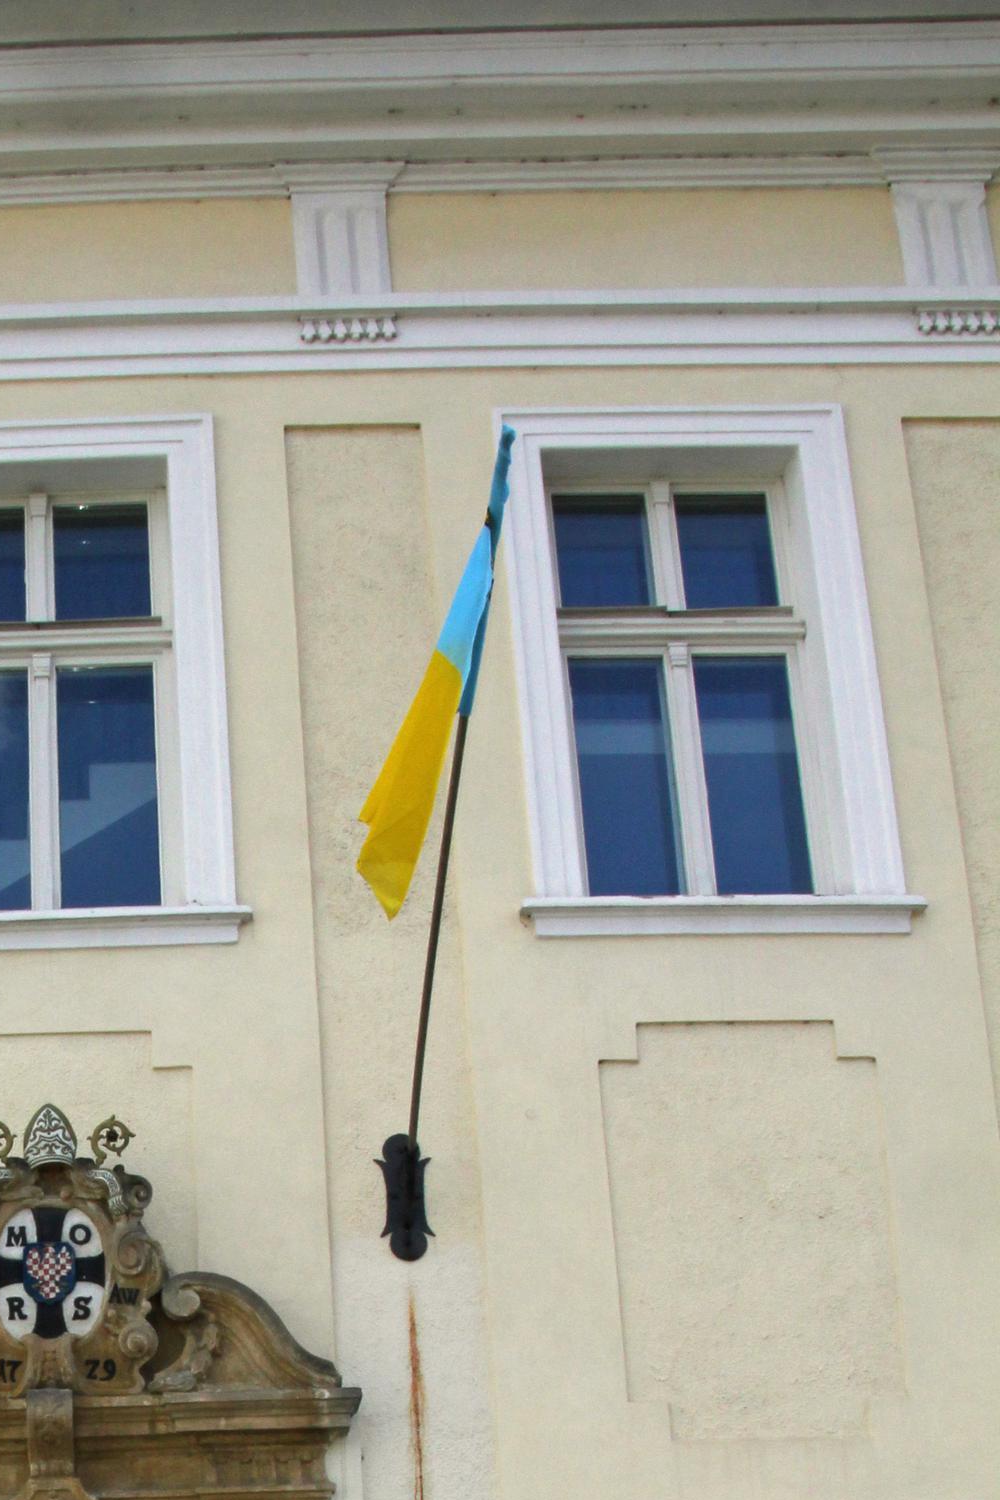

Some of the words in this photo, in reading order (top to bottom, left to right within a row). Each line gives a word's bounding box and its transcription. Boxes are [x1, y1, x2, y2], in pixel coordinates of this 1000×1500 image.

[6, 1226, 28, 1247] M
[69, 1224, 92, 1245] O
[6, 1297, 28, 1320] R
[72, 1296, 93, 1320] S
[0, 1359, 22, 1383] 17
